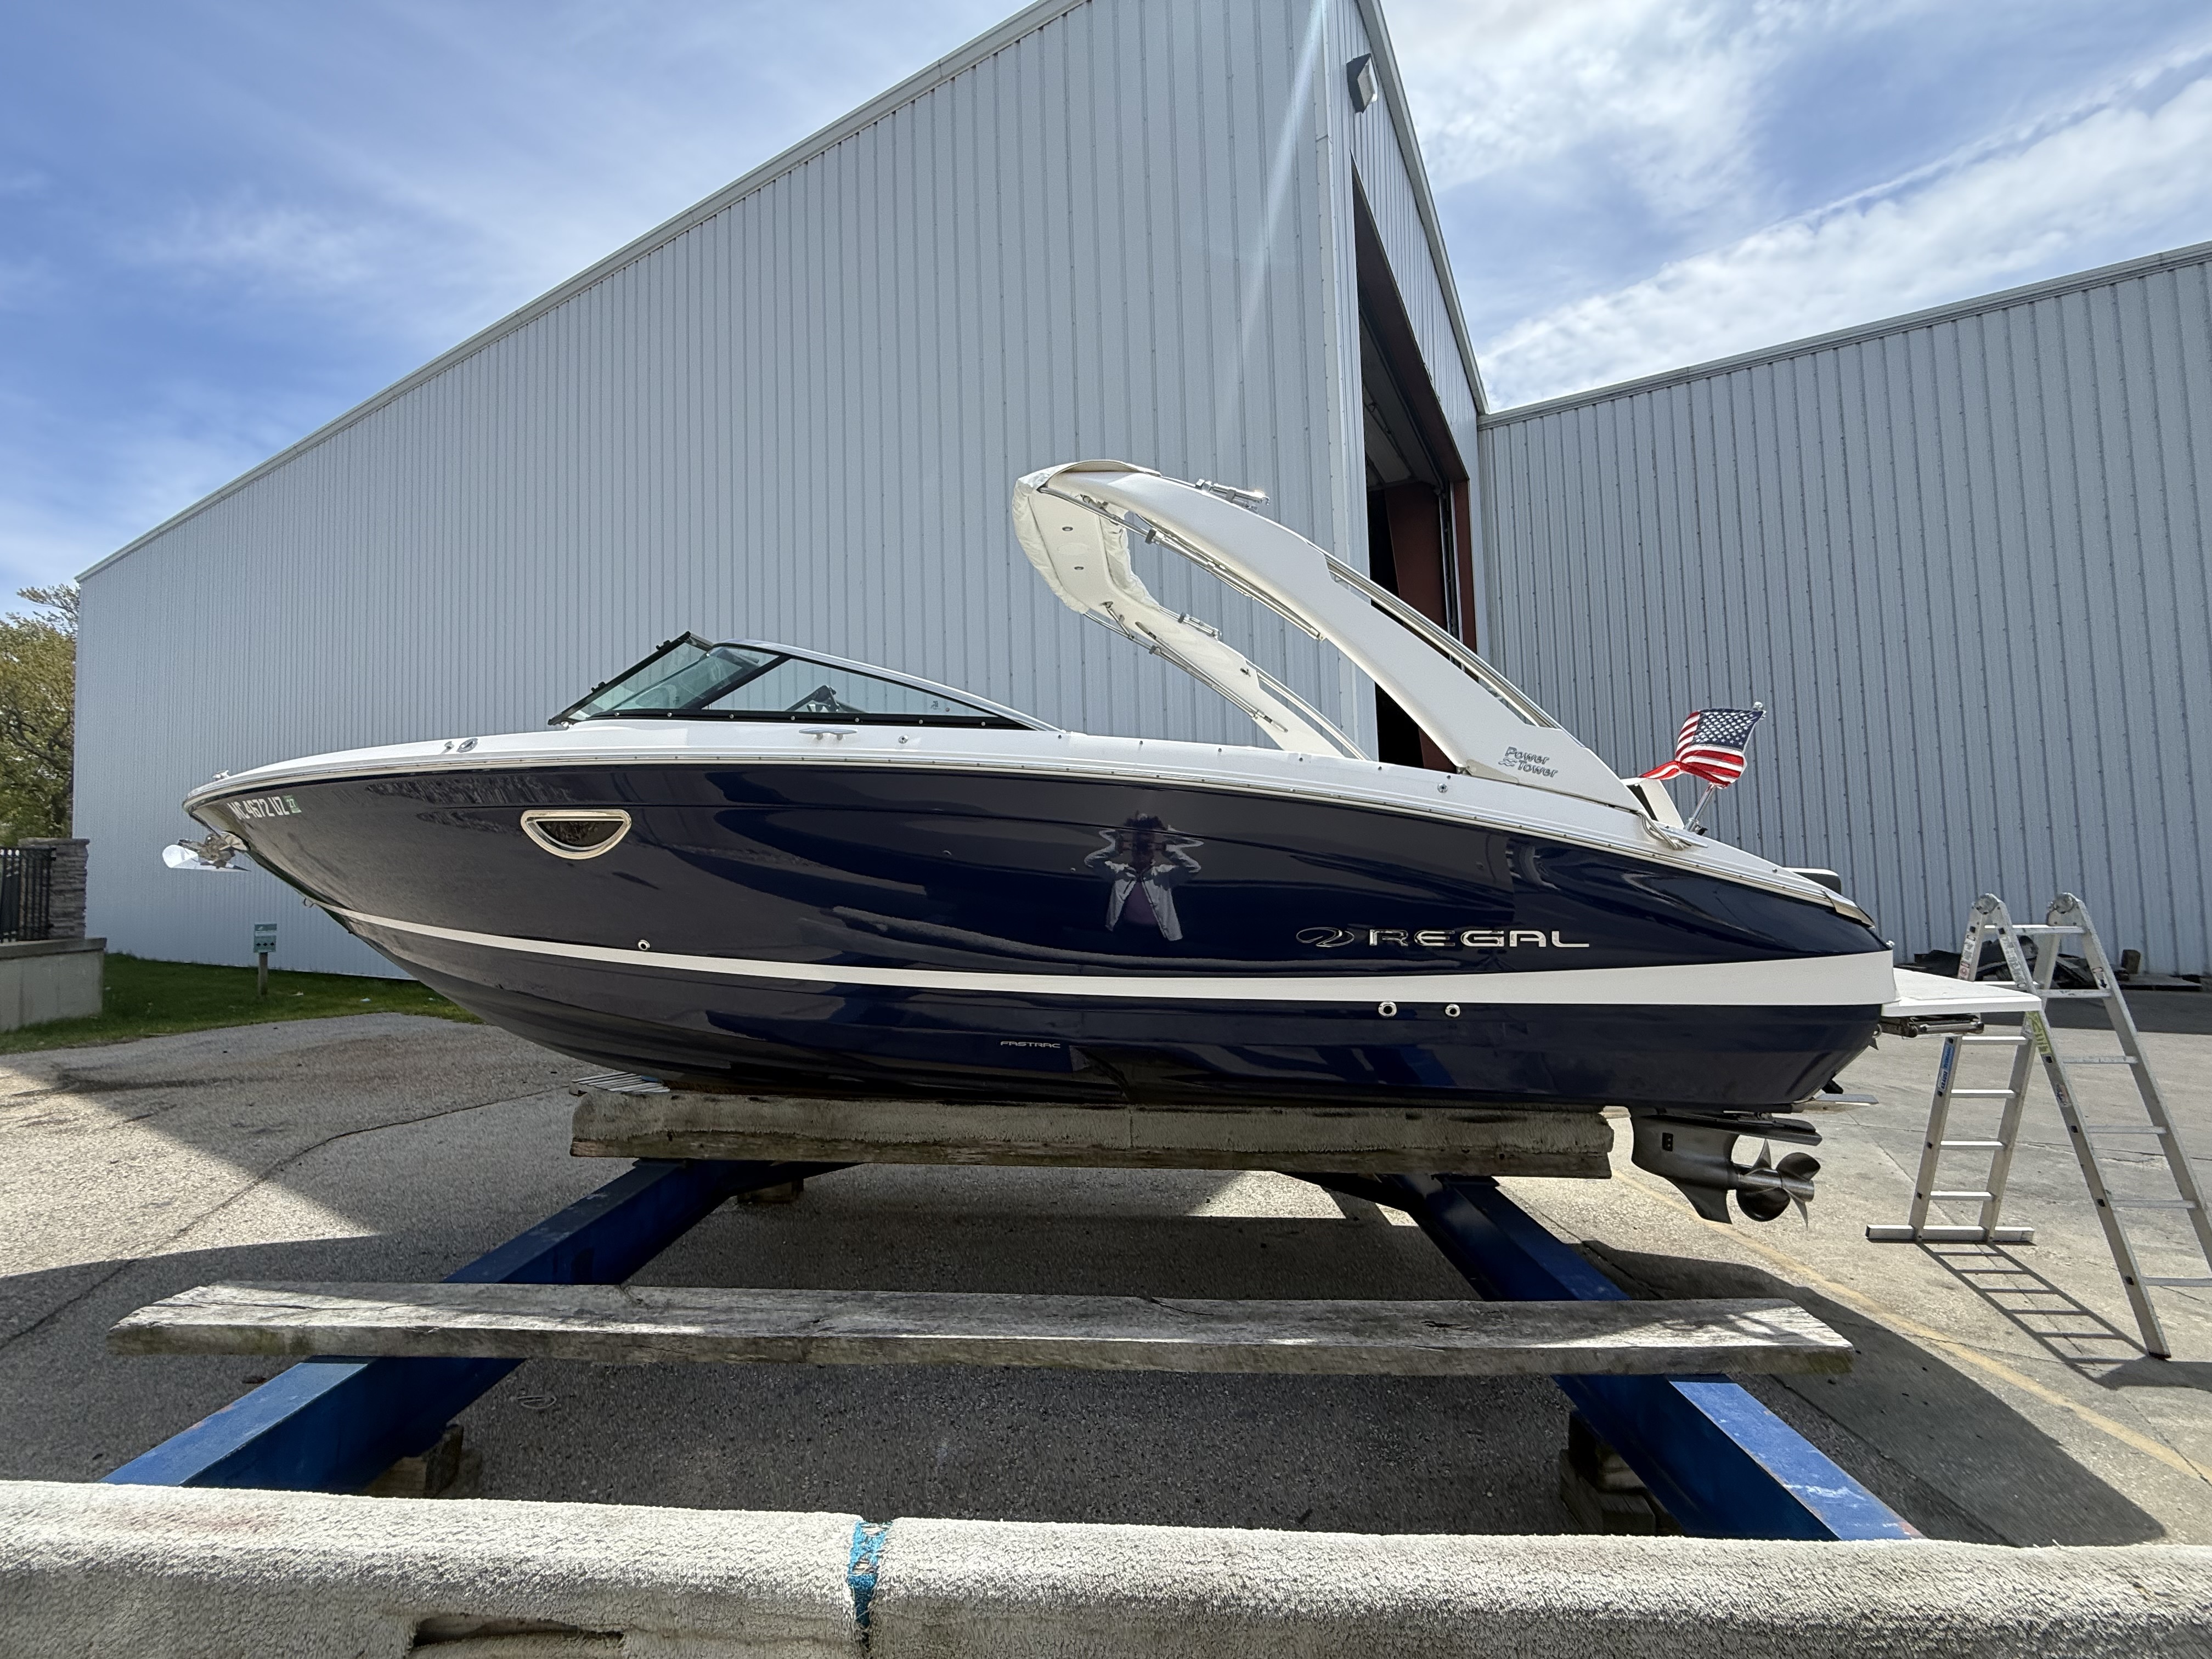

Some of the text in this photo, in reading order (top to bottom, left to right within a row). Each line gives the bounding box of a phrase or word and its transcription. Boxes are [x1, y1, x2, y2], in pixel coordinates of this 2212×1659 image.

[1505, 746, 1549, 765] Power
[1517, 760, 1558, 778] Tower
[226, 796, 290, 820] MC 4672 UZ
[286, 798, 296, 808] 27
[1369, 928, 1590, 948] REGAL
